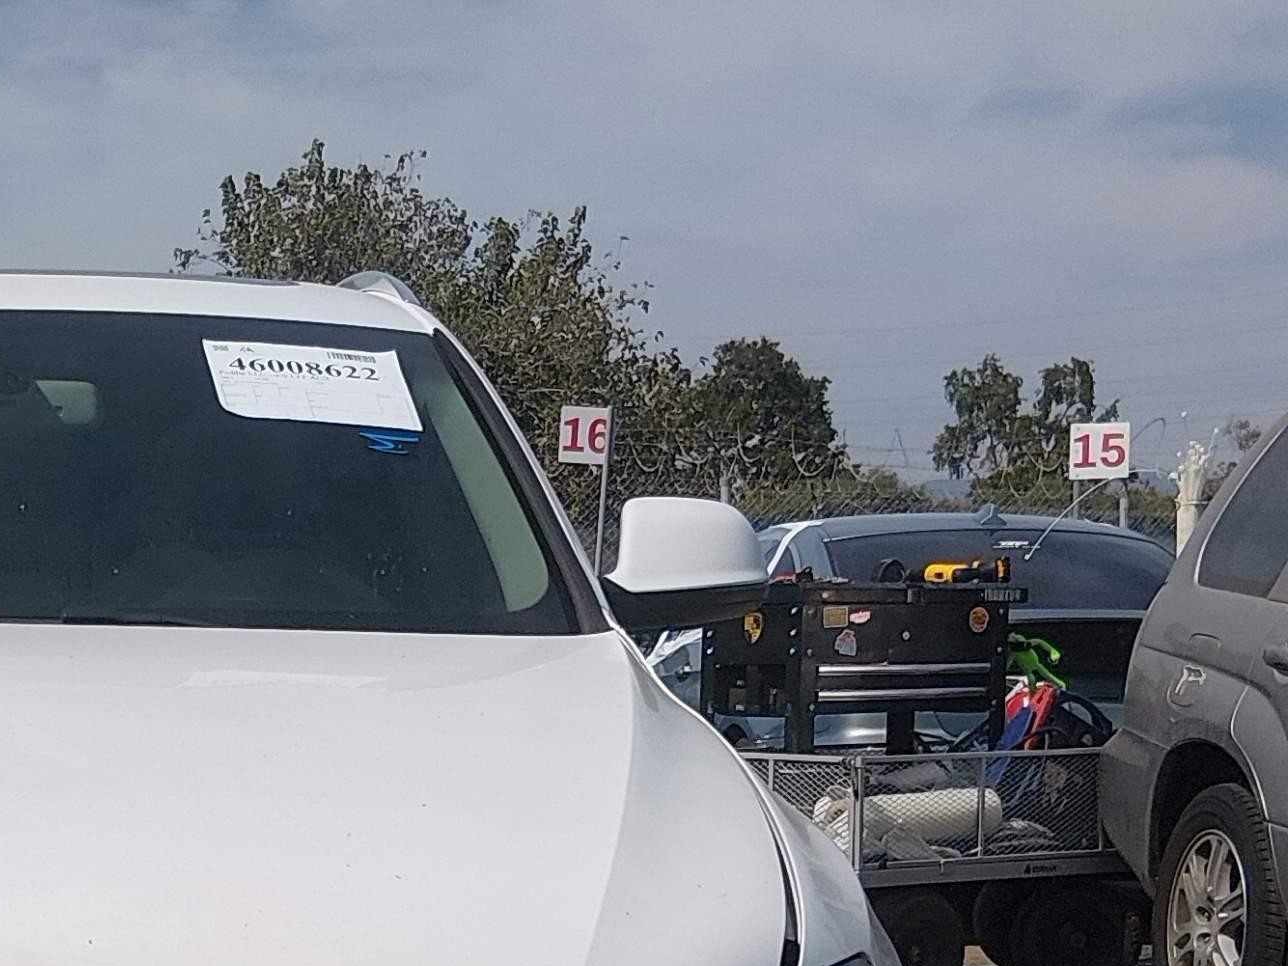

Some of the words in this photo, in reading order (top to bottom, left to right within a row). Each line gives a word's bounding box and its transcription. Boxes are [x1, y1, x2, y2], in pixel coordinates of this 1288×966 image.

[229, 357, 380, 381] 46008622
[563, 418, 608, 454] 16
[1073, 433, 1126, 468] 15
